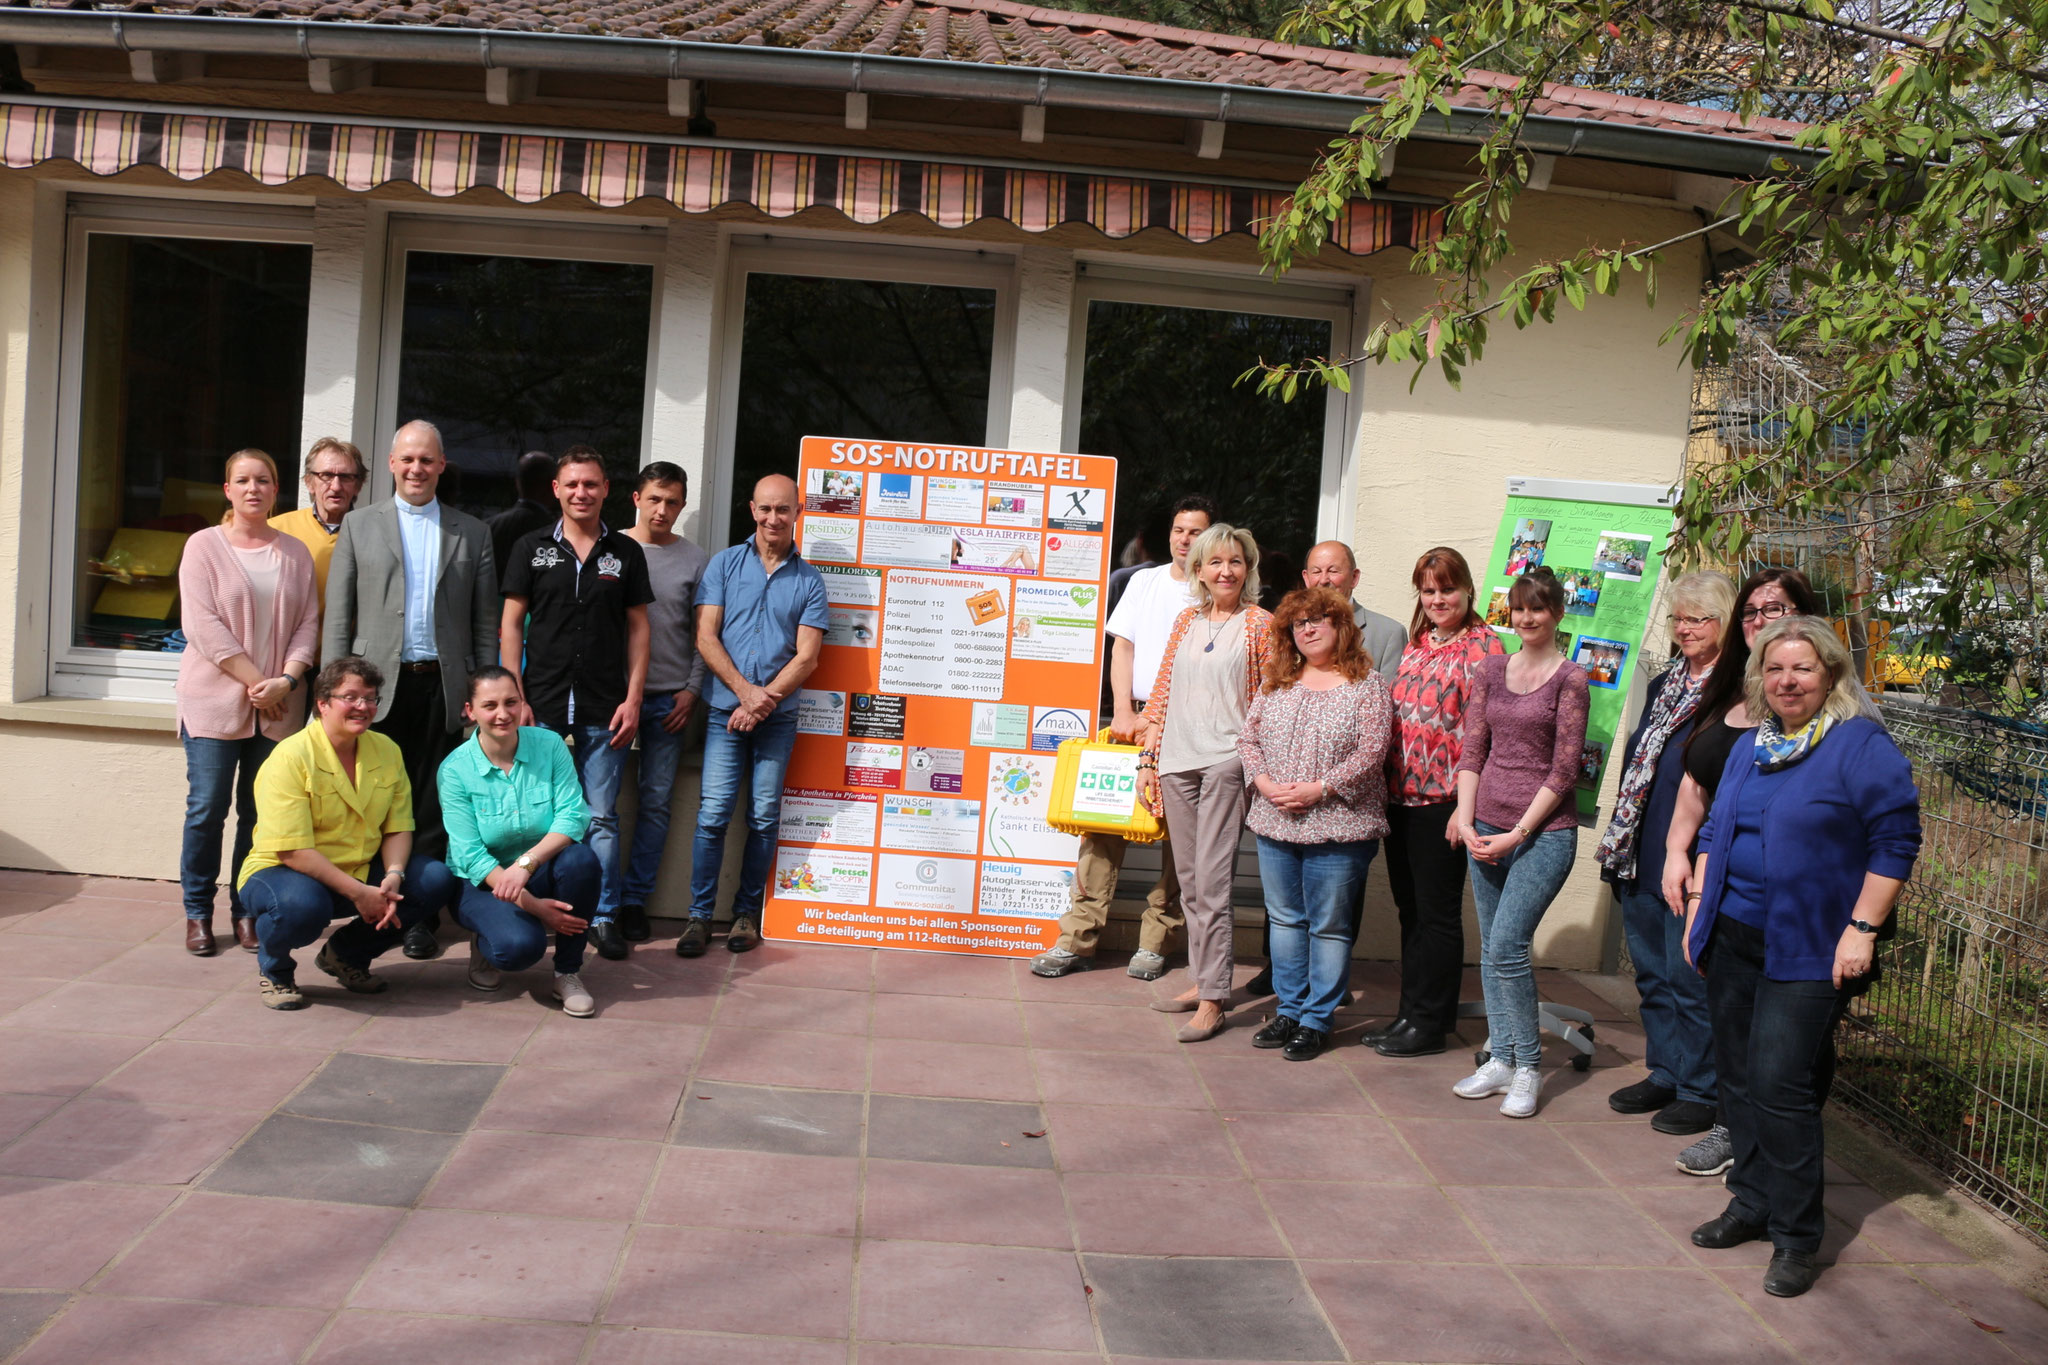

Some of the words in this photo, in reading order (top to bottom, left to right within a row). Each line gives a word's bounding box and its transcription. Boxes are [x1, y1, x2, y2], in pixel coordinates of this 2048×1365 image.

[830, 442, 1087, 481] SOS-NOTRUFTAFEL
[989, 481, 1033, 489] BRANDHUBER
[804, 524, 855, 535] RESIDENZ
[960, 528, 984, 537] ESLA
[986, 529, 1040, 541] HAIRFREE
[1062, 539, 1101, 550] ALLEGRO
[813, 564, 841, 575] NOLD
[842, 567, 878, 577] LORENZ
[889, 575, 985, 589] NOTRUFNUMMERN
[1016, 587, 1069, 597] PROMEDICA
[1073, 591, 1094, 599] PLUS
[887, 597, 926, 607] Euronotruf
[979, 600, 993, 610] SOS
[886, 610, 911, 619] Polizei
[885, 624, 943, 636] DRK-Flugdienst
[950, 629, 1005, 639] 0221-91749939
[884, 638, 935, 648] Bundespolizei
[954, 643, 1004, 653] 0800-6888000
[883, 651, 945, 662] Apothekennotruf
[954, 656, 1003, 667] 0800-00-2283
[882, 664, 905, 673] ADAC
[947, 669, 1002, 680] 01802-2222222
[881, 678, 943, 690] Telefonseelsorge
[950, 683, 1001, 693] 0800-1110111
[1045, 718, 1078, 730] maxi
[783, 787, 798, 795] Ihre
[799, 788, 834, 798] Apotheken
[784, 798, 815, 807] Apotheke
[885, 796, 933, 808] WUNSCH
[1000, 821, 1028, 832] Sankt
[832, 867, 869, 877] Pietsch
[983, 862, 1022, 876] Hewig
[895, 881, 957, 893] Communitas
[981, 875, 1064, 888] Autoglasservice
[1021, 888, 1062, 898] Kirchenweg
[893, 900, 955, 910] www.c-sozial.de
[1003, 901, 1044, 910] 07231-155
[804, 908, 824, 919] Wir
[826, 909, 884, 924] bedanken
[886, 916, 907, 926] uns
[909, 915, 928, 927] bei
[929, 918, 958, 929] allen
[960, 920, 1022, 934] Sponsoren
[1024, 924, 1042, 935] für
[796, 922, 815, 934] die
[817, 924, 884, 941] Beteiligung
[886, 931, 905, 941] am
[908, 931, 1047, 951] 112-Rettungsleitsystem.
